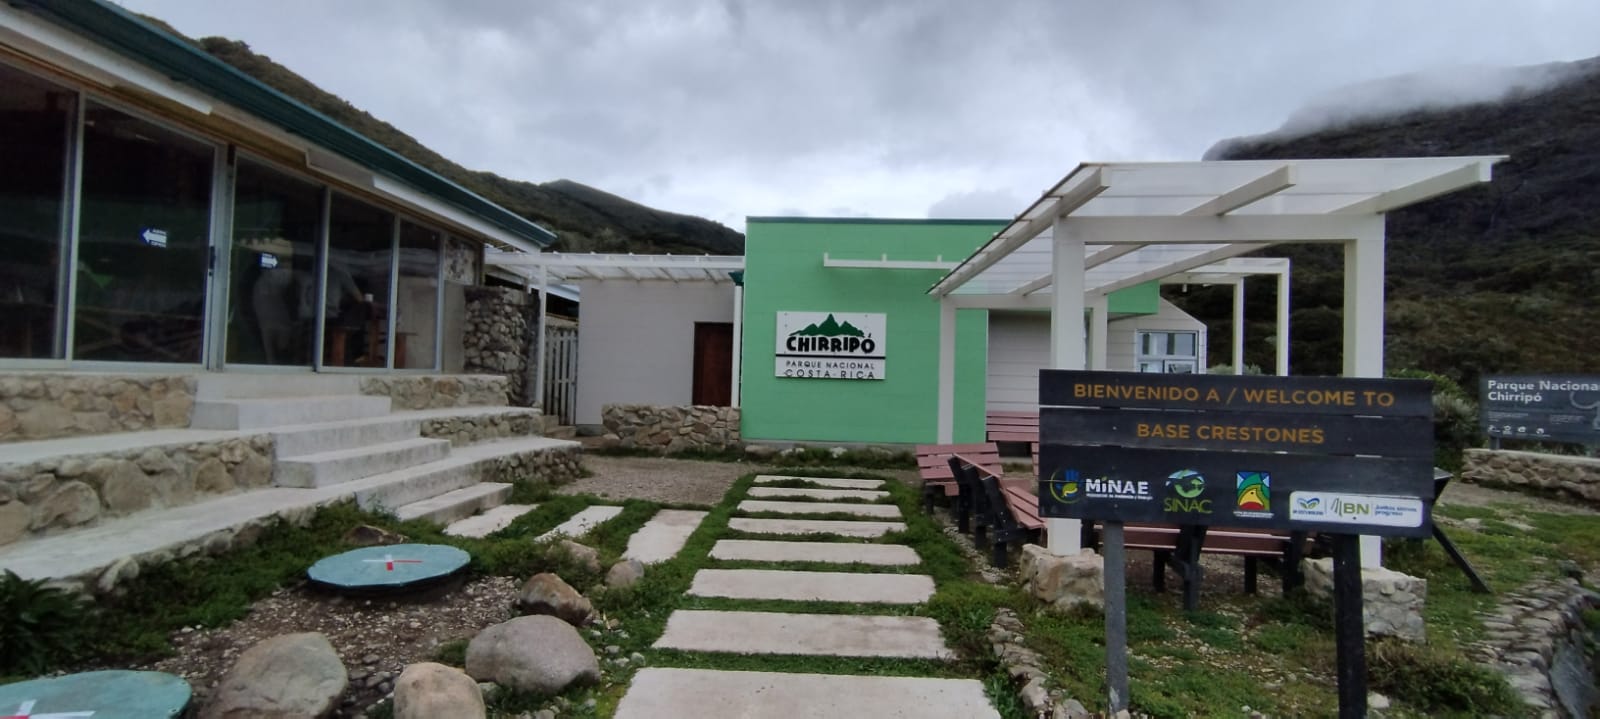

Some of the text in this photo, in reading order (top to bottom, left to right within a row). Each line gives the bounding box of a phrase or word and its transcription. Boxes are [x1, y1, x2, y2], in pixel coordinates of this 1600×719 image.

[786, 333, 876, 354] CHIRRIPÓ
[786, 360, 875, 370] PARQUE NACIONAL
[785, 368, 875, 379] COSTA RICA
[1487, 380, 1600, 393] Parque Naciona
[1074, 383, 1395, 407] BIENVENIDO A / WELCOME TO
[1487, 391, 1543, 404] Chirripó
[1136, 423, 1325, 444] BASE CRESTONES
[1163, 497, 1213, 514] SINAC
